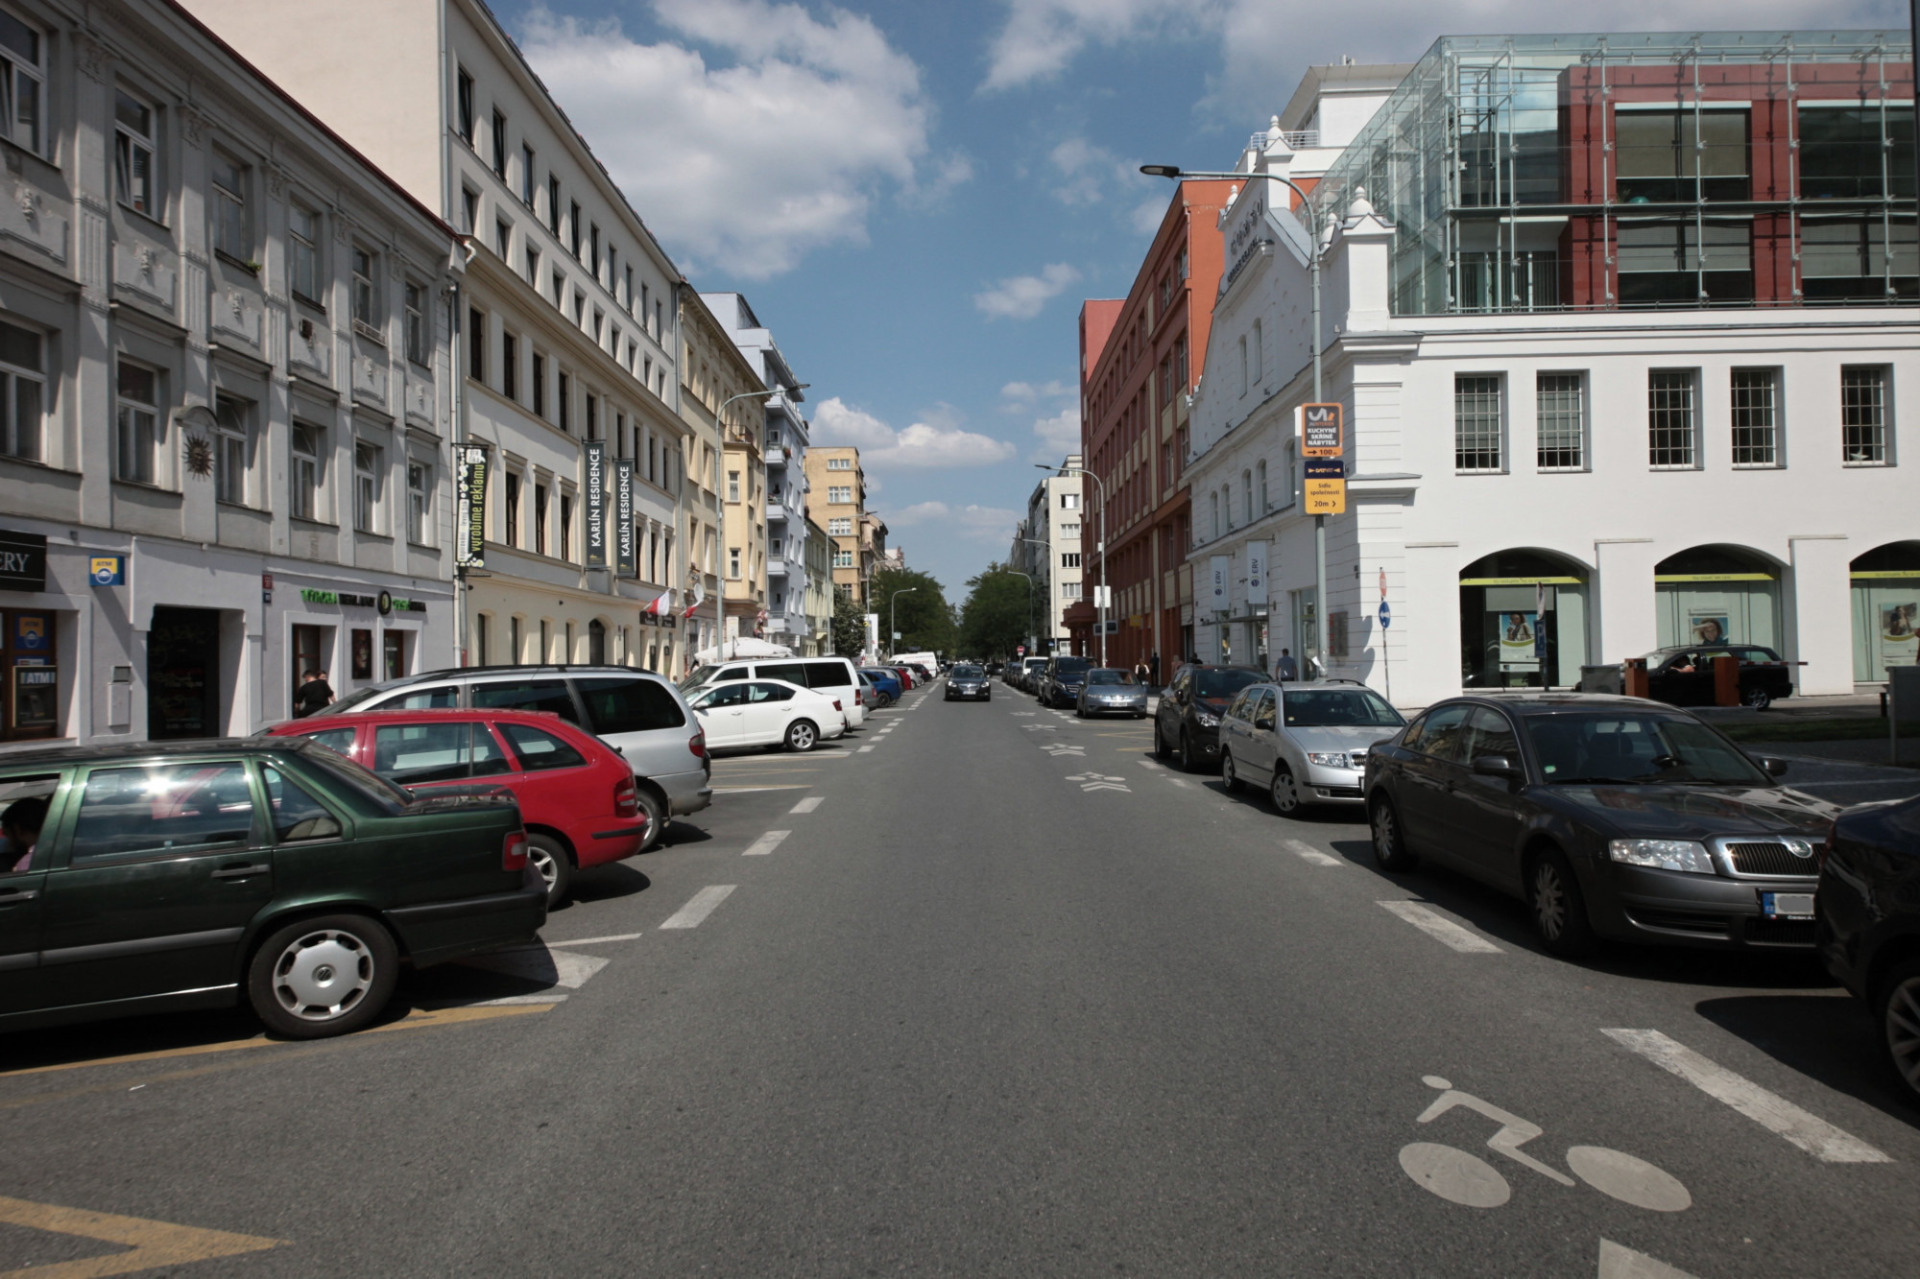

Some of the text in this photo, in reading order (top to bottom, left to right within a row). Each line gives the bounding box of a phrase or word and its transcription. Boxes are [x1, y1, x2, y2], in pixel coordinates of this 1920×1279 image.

[470, 465, 485, 504] reklamu
[588, 448, 600, 547] KARLÍN RESIDENCE
[1314, 500, 1329, 508] 20m
[469, 507, 483, 552] vyrobíme
[618, 466, 630, 557] KARLÍN RESIDENCE
[26, 672, 50, 684] ATM
